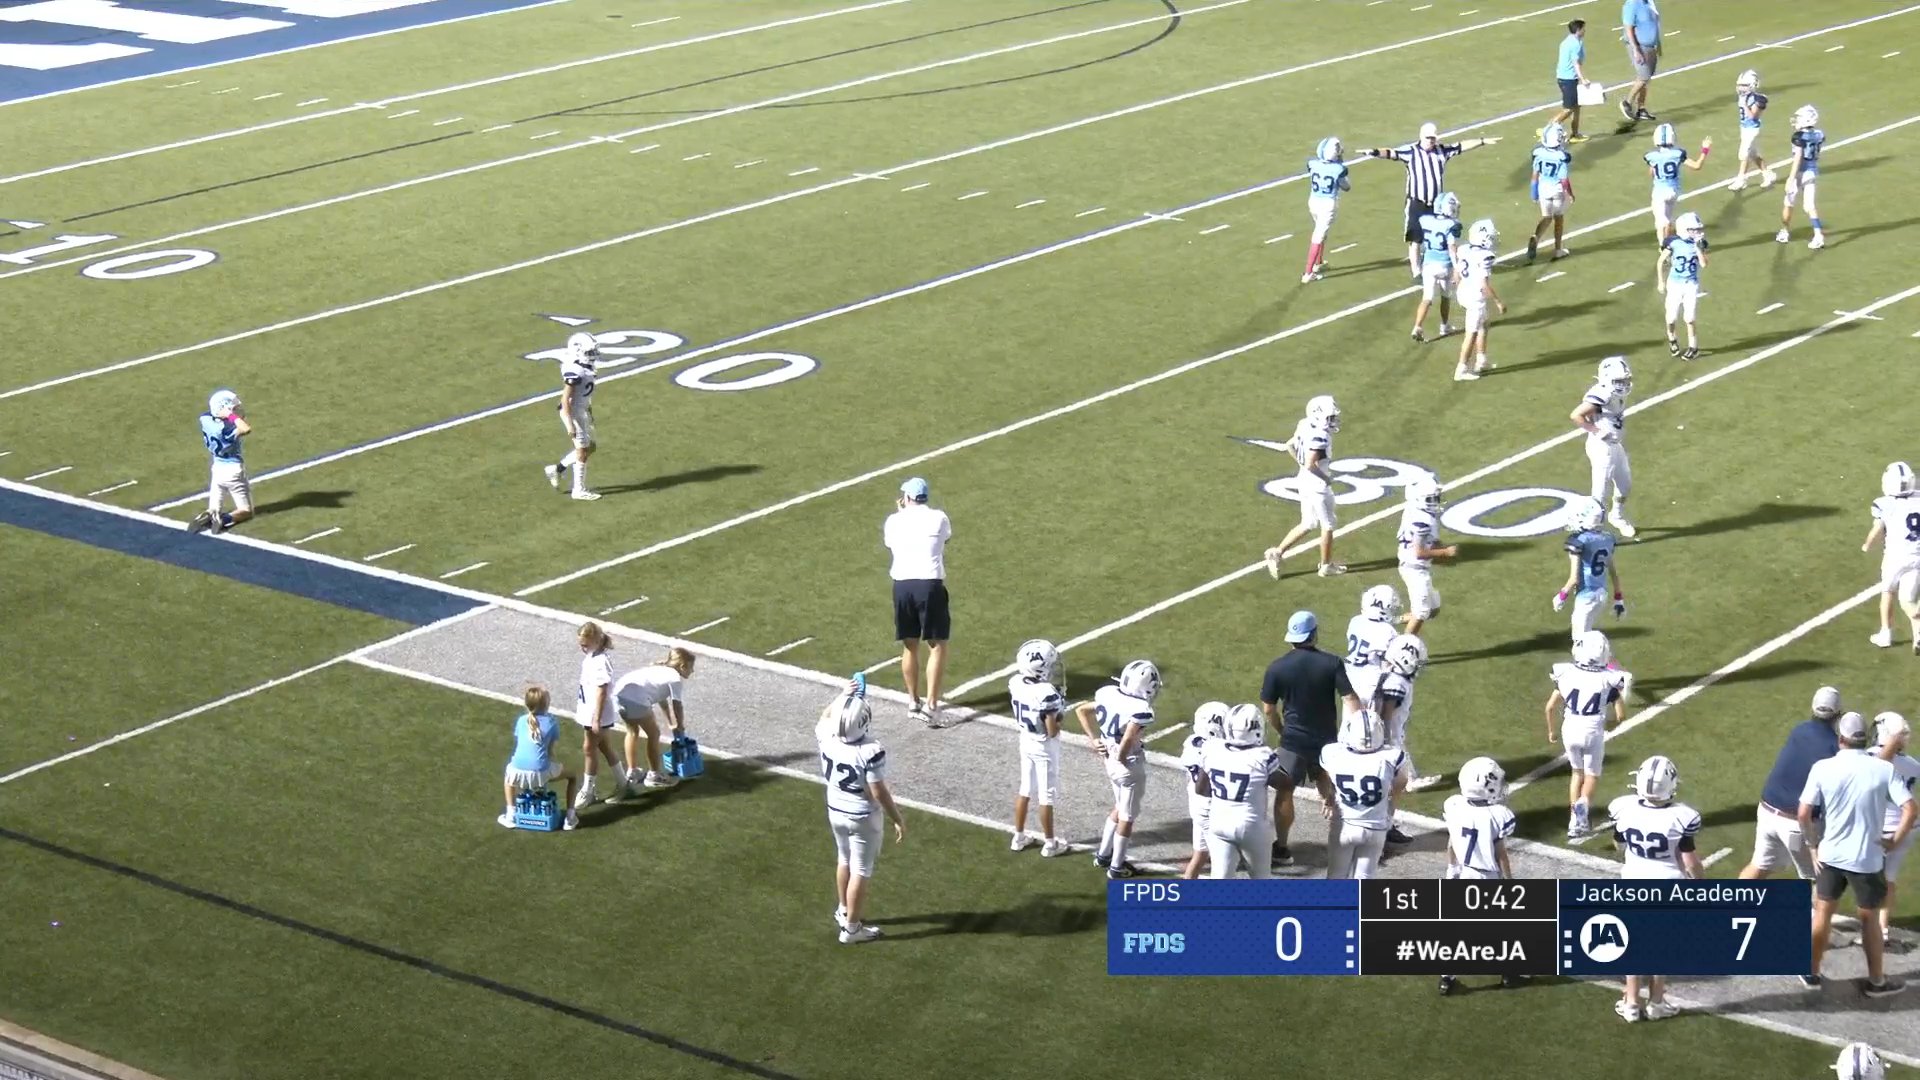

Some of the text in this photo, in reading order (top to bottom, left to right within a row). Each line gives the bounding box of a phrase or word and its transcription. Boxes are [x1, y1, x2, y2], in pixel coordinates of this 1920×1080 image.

[1311, 172, 1335, 194] 63
[1538, 160, 1557, 178] 17
[1654, 161, 1678, 180] 19
[1422, 228, 1448, 251] 53
[1674, 255, 1698, 274] 36
[1590, 549, 1608, 577] 6
[1348, 634, 1370, 667] 25
[1566, 688, 1601, 716] 44
[1095, 705, 1124, 744] 24
[822, 752, 865, 793] 72
[1210, 768, 1250, 802] 57
[1336, 774, 1382, 807] 58
[1461, 827, 1478, 865] 7
[1625, 828, 1671, 859] 62
